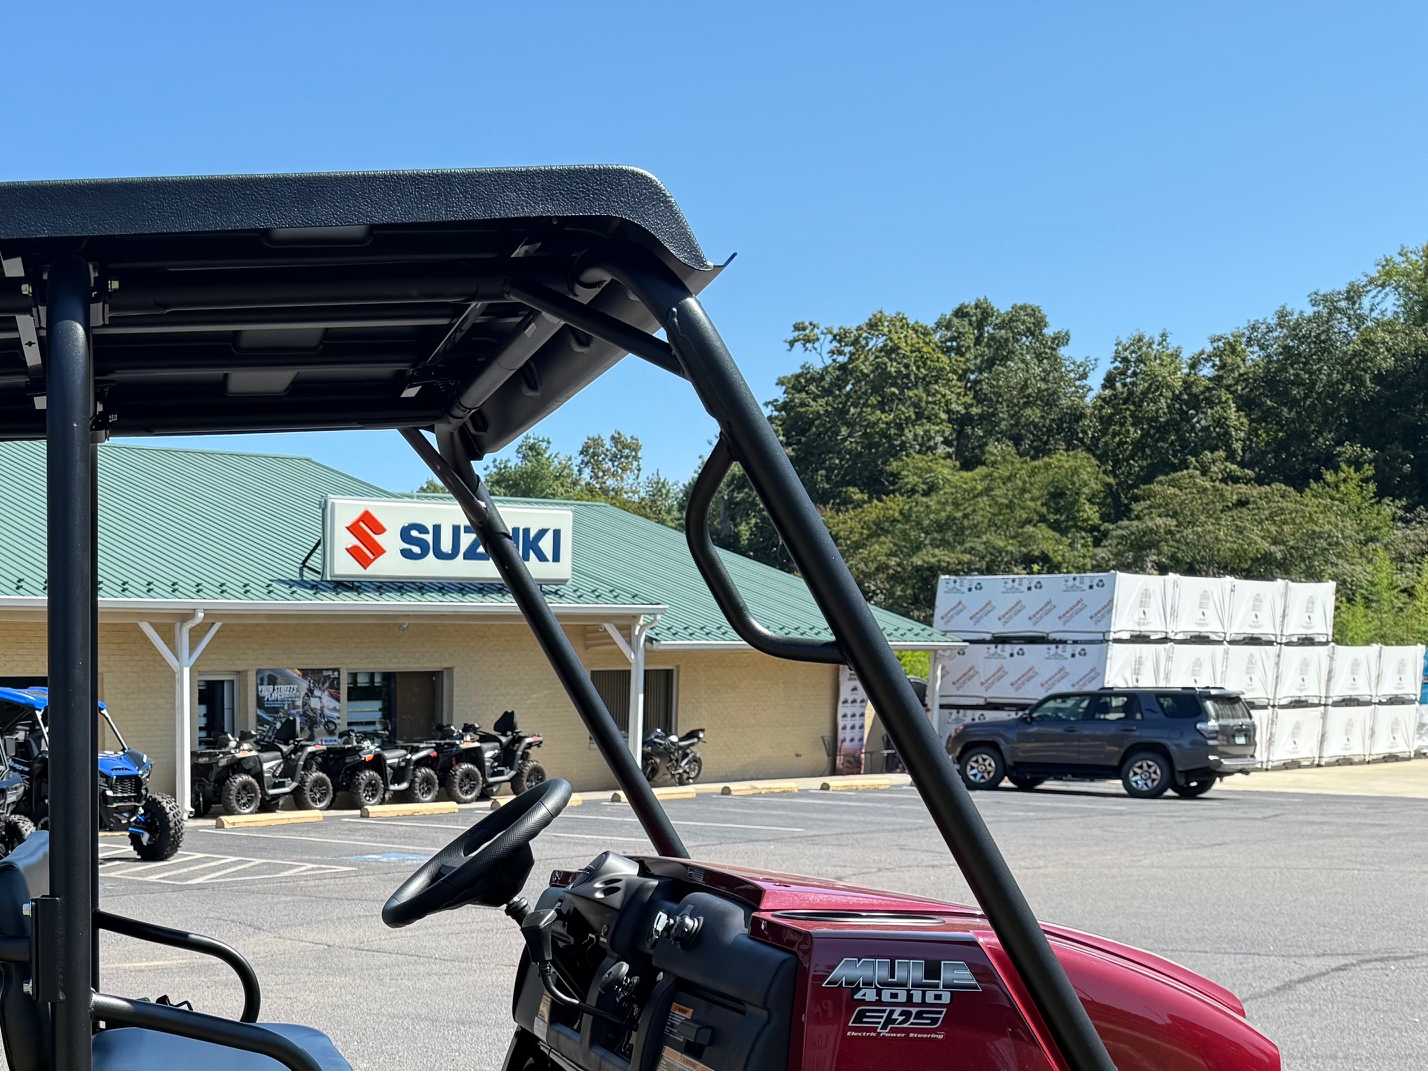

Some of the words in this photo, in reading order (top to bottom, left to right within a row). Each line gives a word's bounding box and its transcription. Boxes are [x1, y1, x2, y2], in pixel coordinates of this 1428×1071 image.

[822, 958, 983, 992] MULE
[854, 988, 951, 1004] 4010
[848, 1006, 947, 1033] EPS
[908, 1032, 945, 1040] Steering
